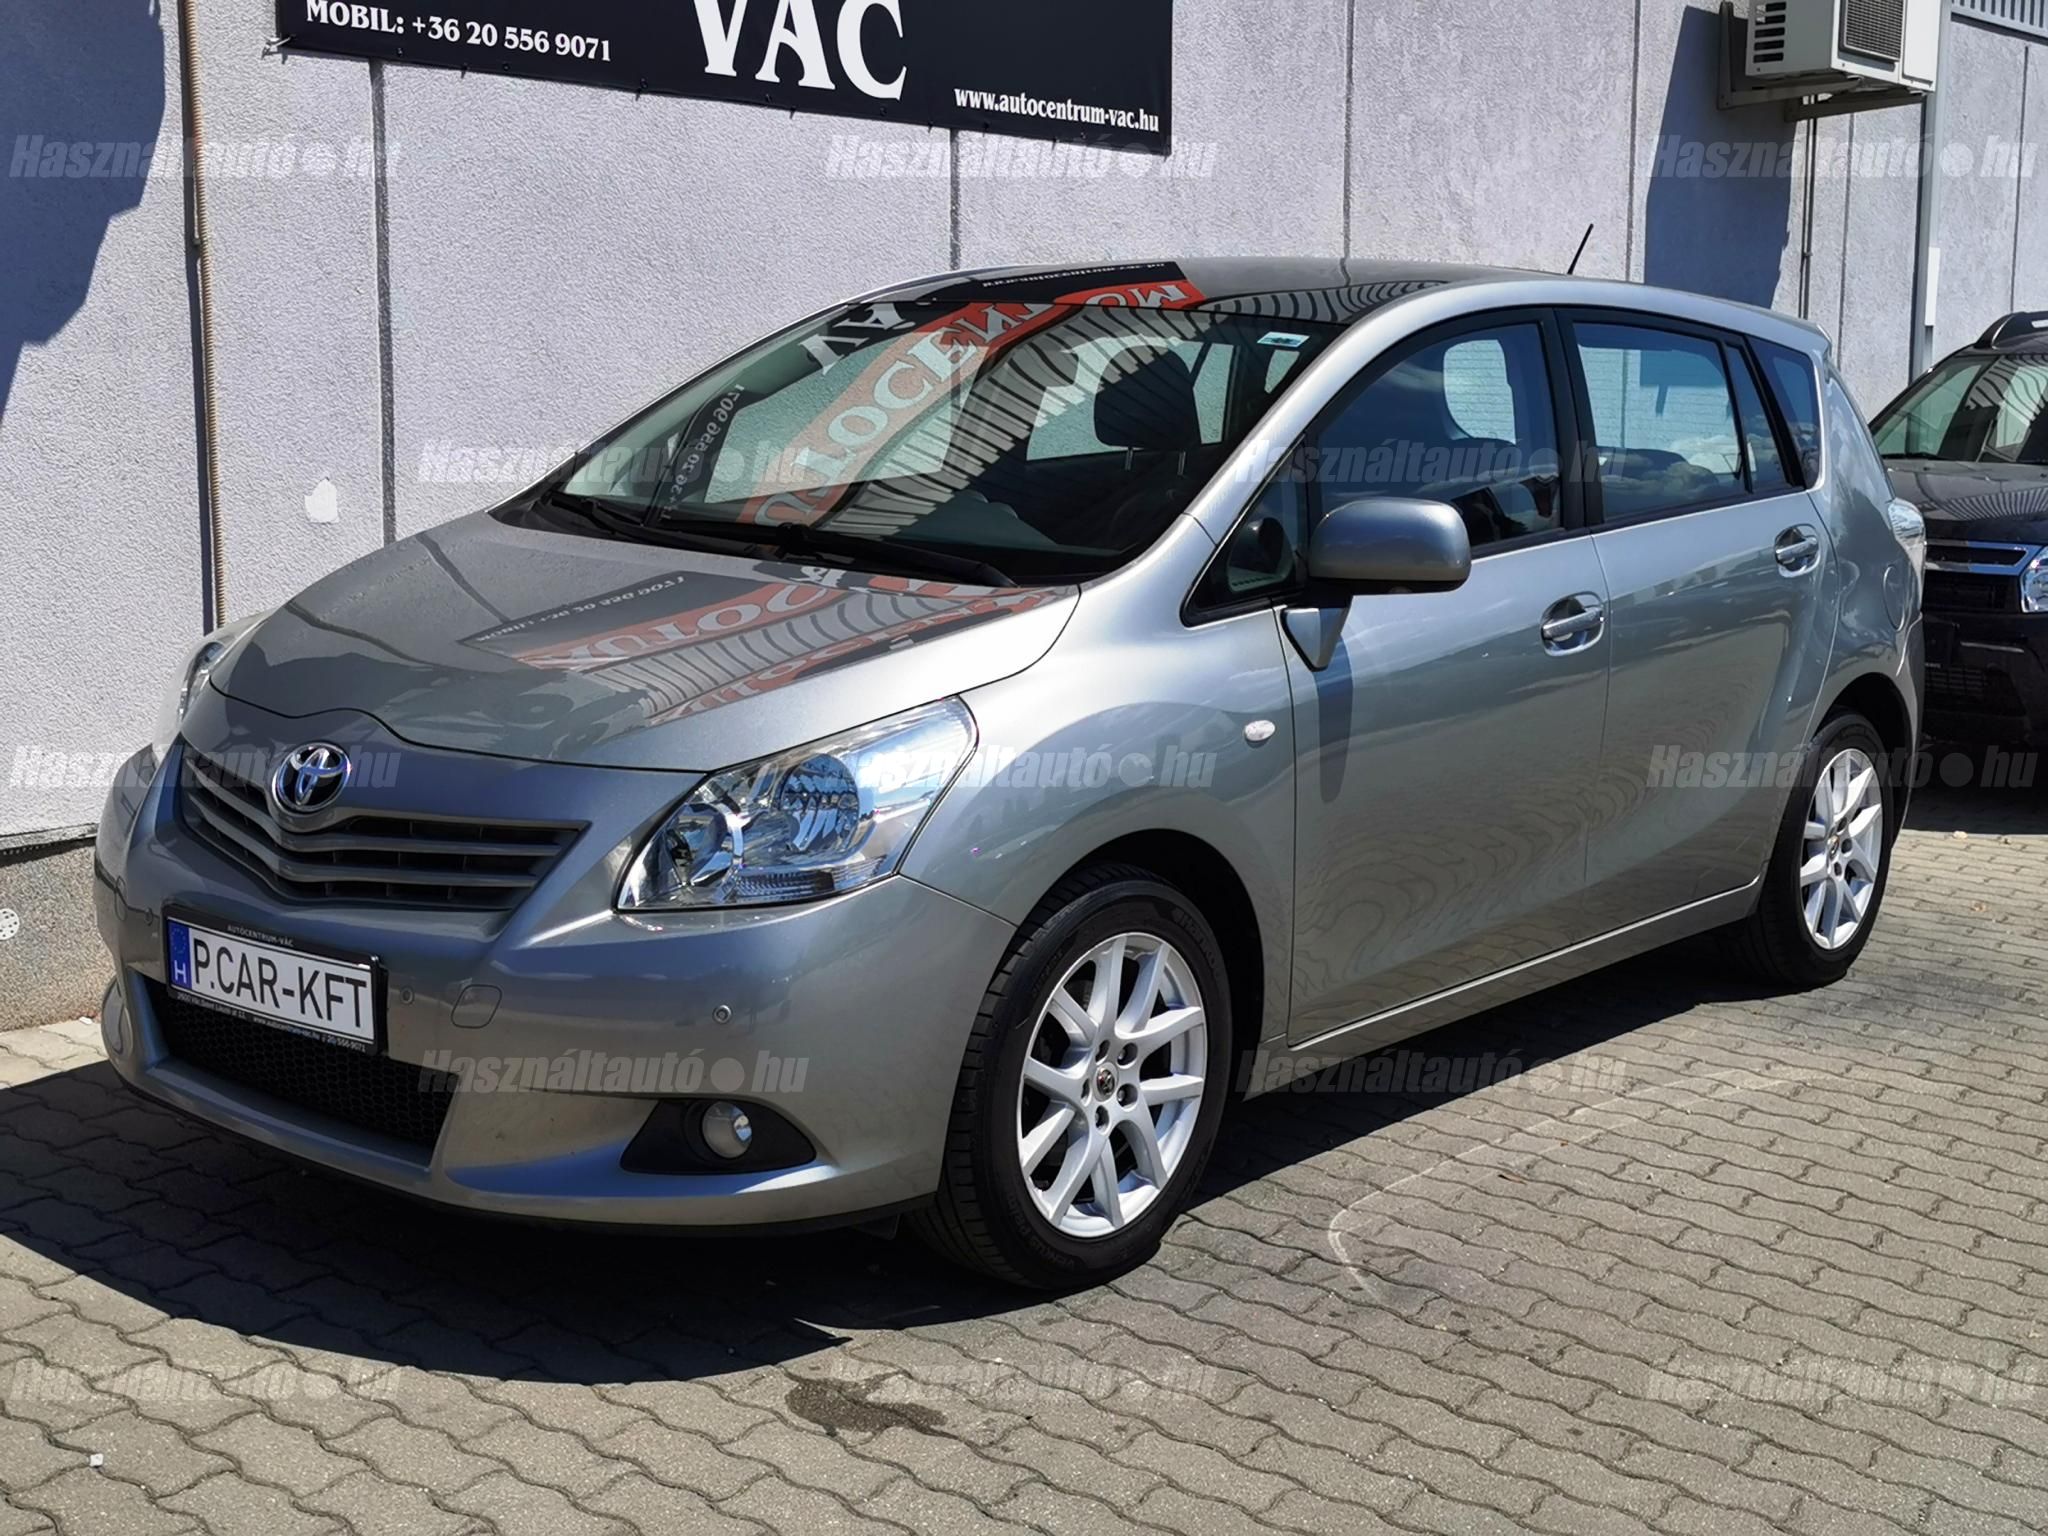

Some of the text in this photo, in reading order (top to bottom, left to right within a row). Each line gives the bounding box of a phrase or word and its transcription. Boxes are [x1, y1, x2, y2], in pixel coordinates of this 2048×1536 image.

[305, 0, 611, 62] MOBIL: +36 20 556 9071
[954, 87, 1160, 132] www.autocentrum-vac.hu
[174, 960, 187, 984] H
[193, 937, 367, 1028] P.CAR-KFT
